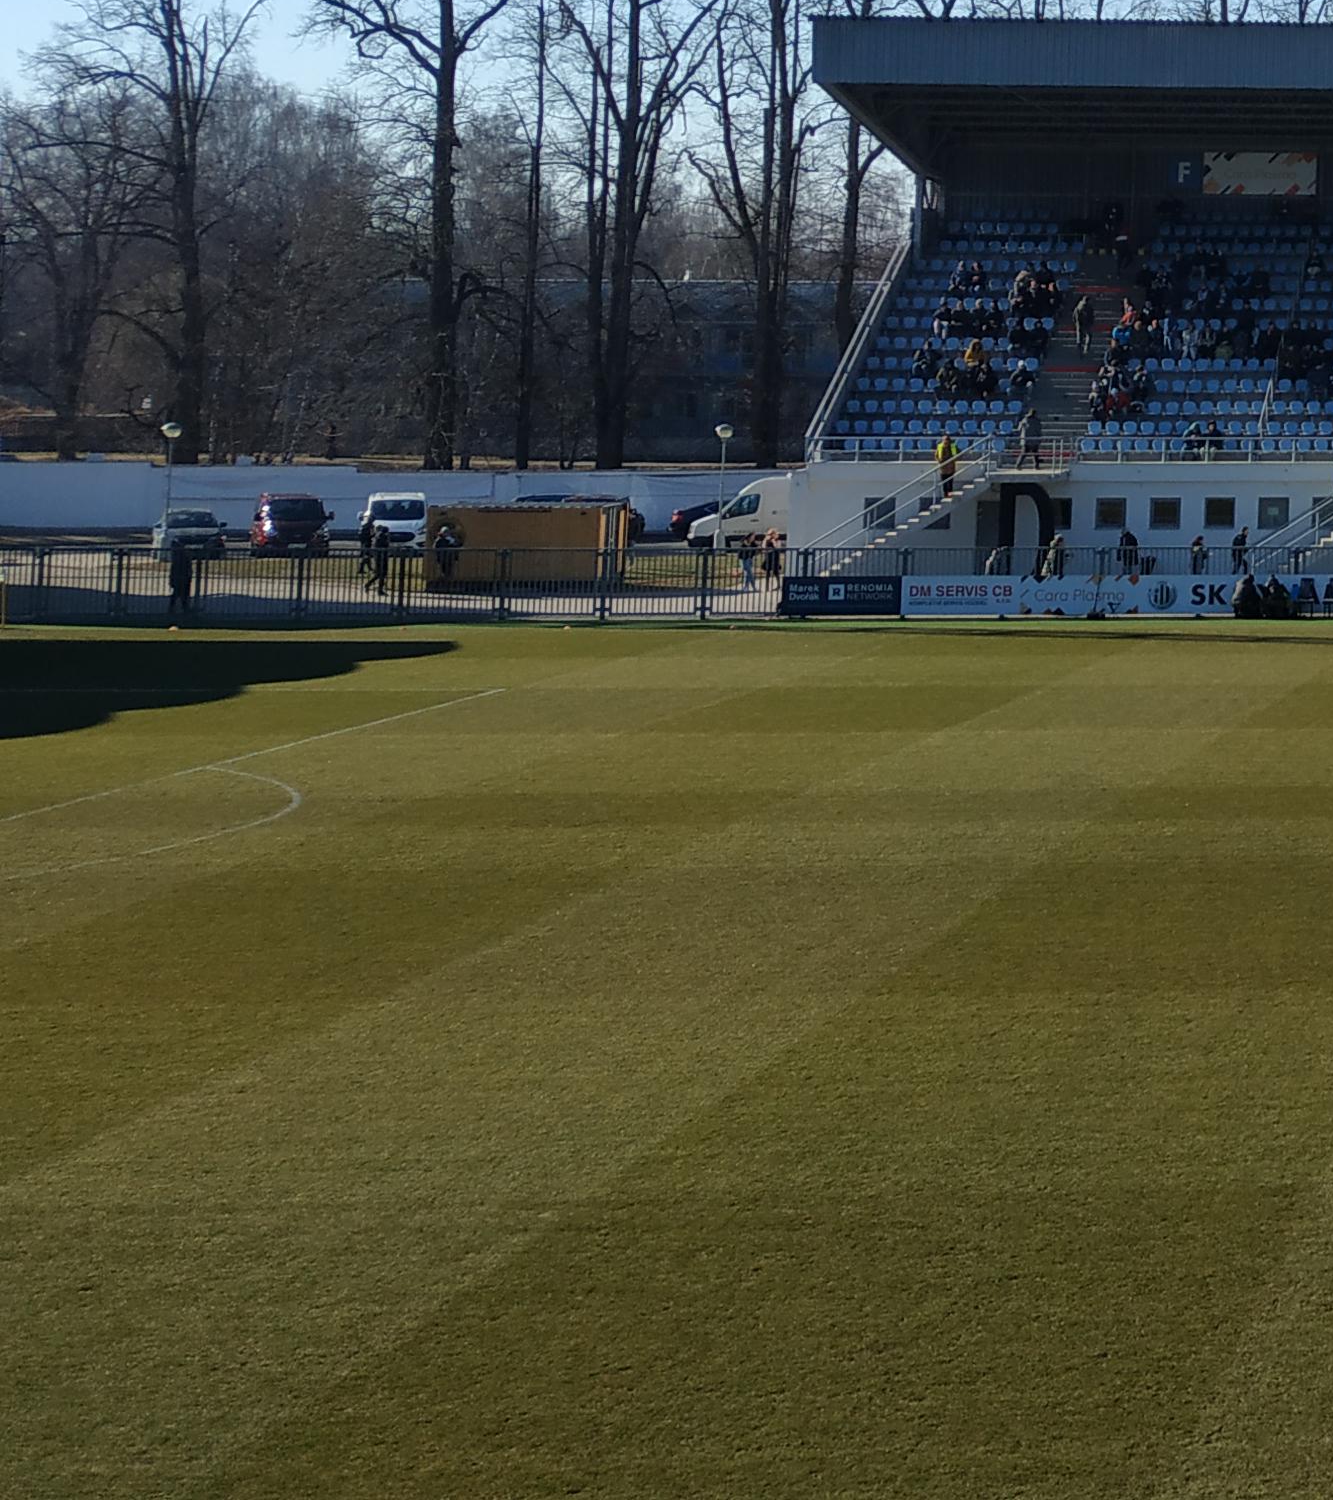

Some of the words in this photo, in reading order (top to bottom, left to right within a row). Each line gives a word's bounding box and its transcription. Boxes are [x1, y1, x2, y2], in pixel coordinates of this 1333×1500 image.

[1177, 162, 1191, 184] F
[847, 584, 894, 592] RENOMIA
[908, 585, 931, 597] DM
[936, 585, 988, 597] SERVIS
[992, 585, 1013, 597] CB
[847, 592, 894, 600] NETWORK
[1034, 589, 1068, 602] Cara
[1073, 588, 1125, 602] Plasma
[1190, 584, 1228, 606] SK
